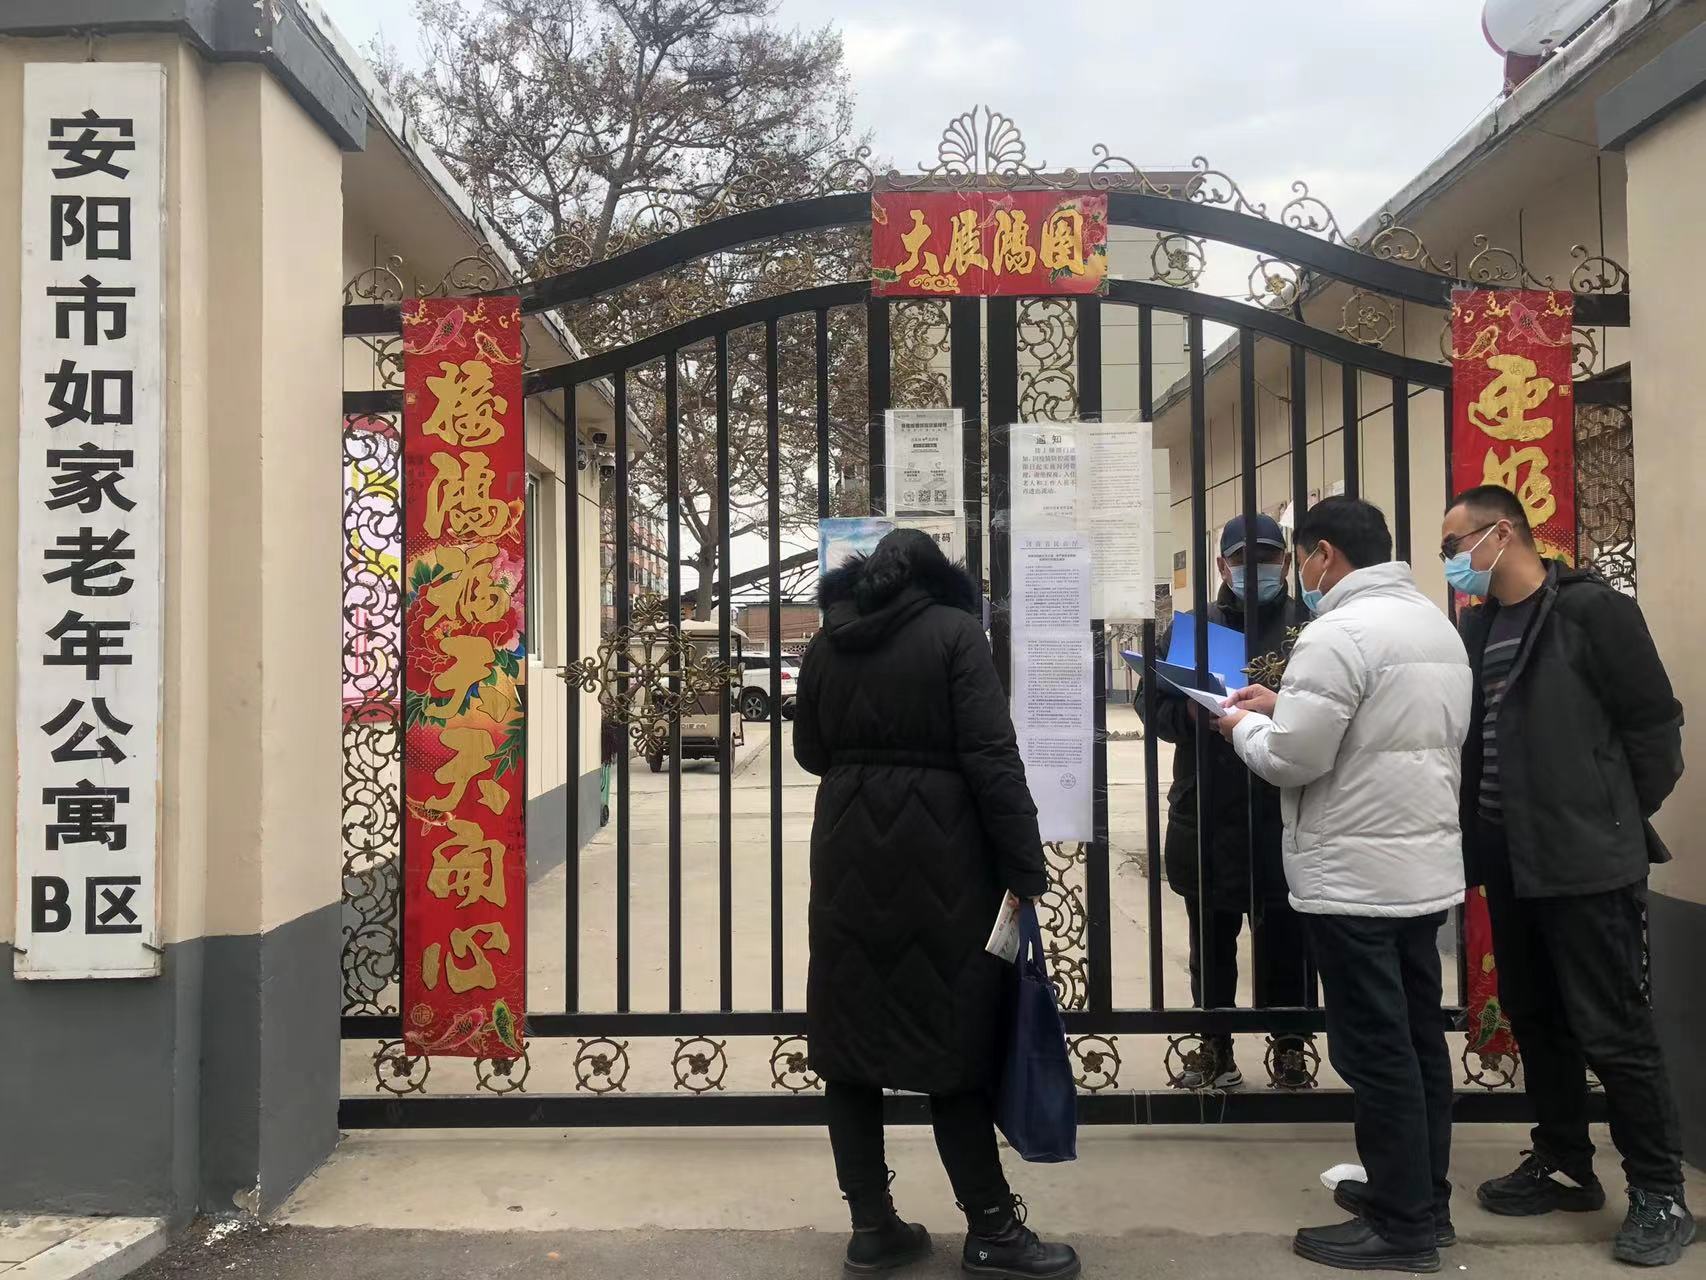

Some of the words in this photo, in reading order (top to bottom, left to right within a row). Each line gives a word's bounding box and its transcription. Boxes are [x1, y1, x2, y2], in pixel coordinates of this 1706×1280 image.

[1034, 433, 1063, 445] 通知
[41, 110, 136, 850] 安阳市如家老年公寓
[32, 876, 142, 934] B区
